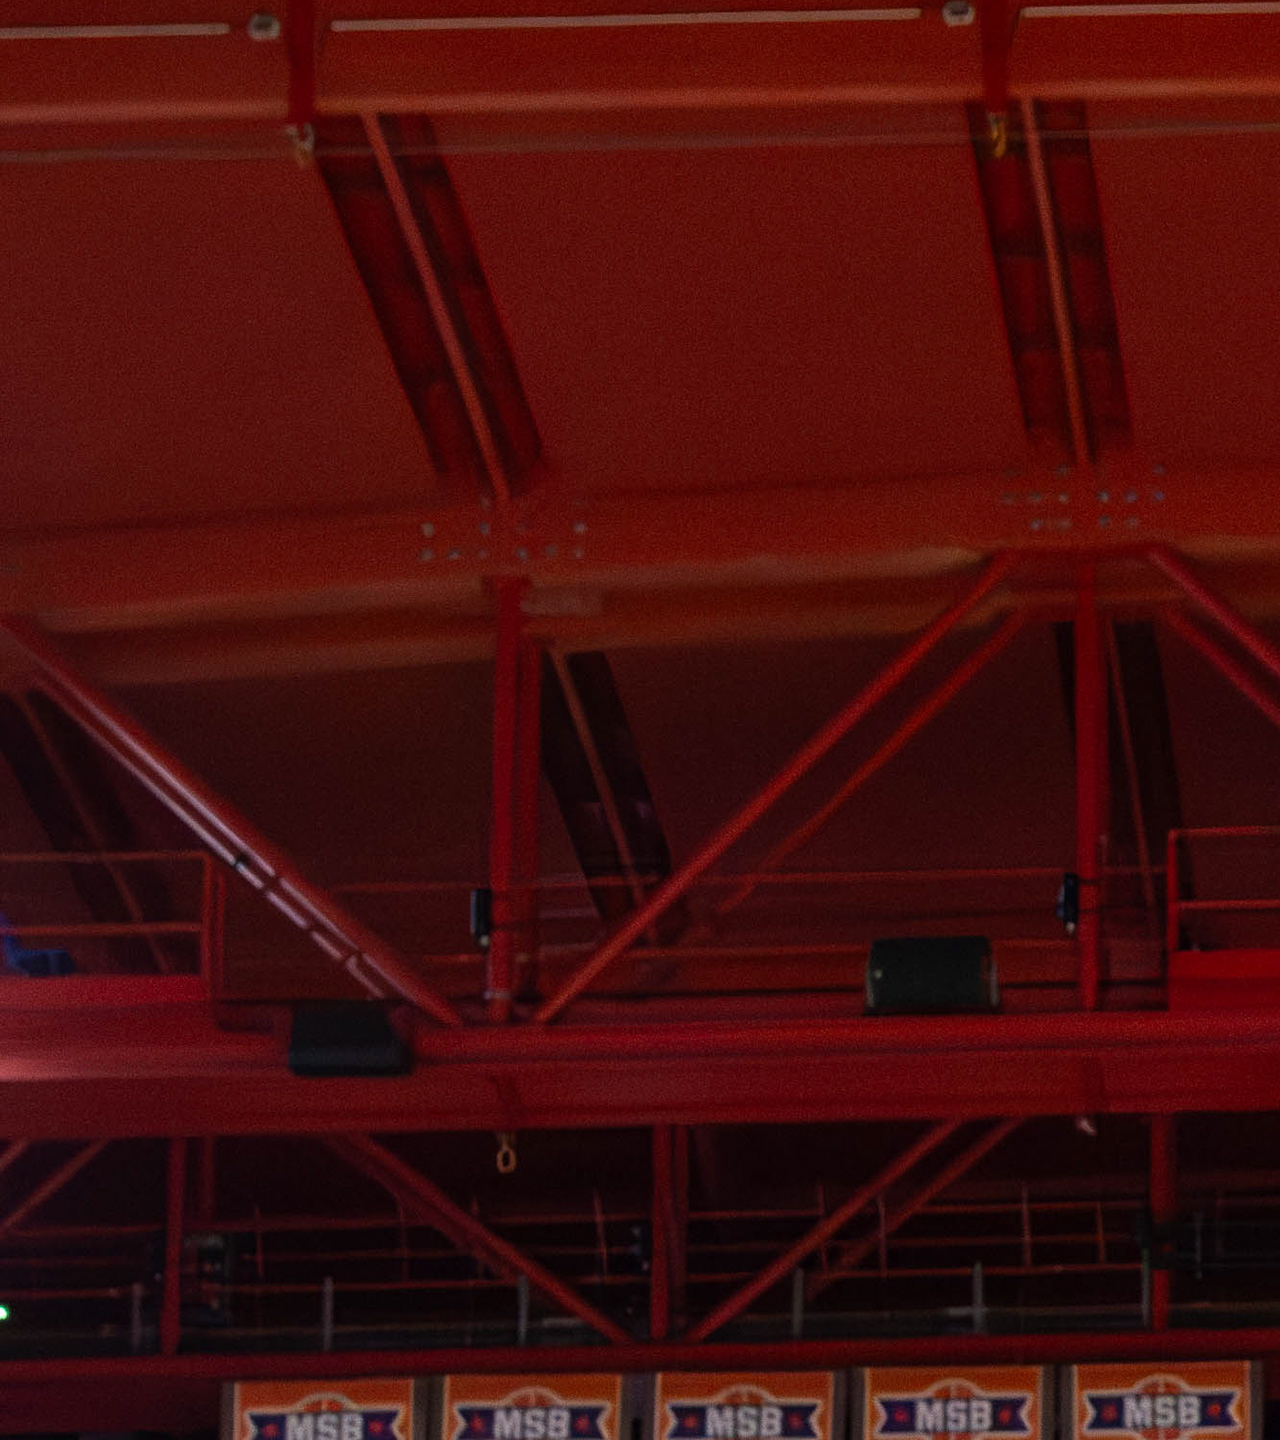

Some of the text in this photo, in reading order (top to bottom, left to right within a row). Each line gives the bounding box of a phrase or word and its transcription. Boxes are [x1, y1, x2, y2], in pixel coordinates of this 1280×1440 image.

[493, 1408, 570, 1440] MSB
[704, 1406, 784, 1438] MSB
[915, 1399, 993, 1433] MSB
[1123, 1395, 1201, 1428] MSB
